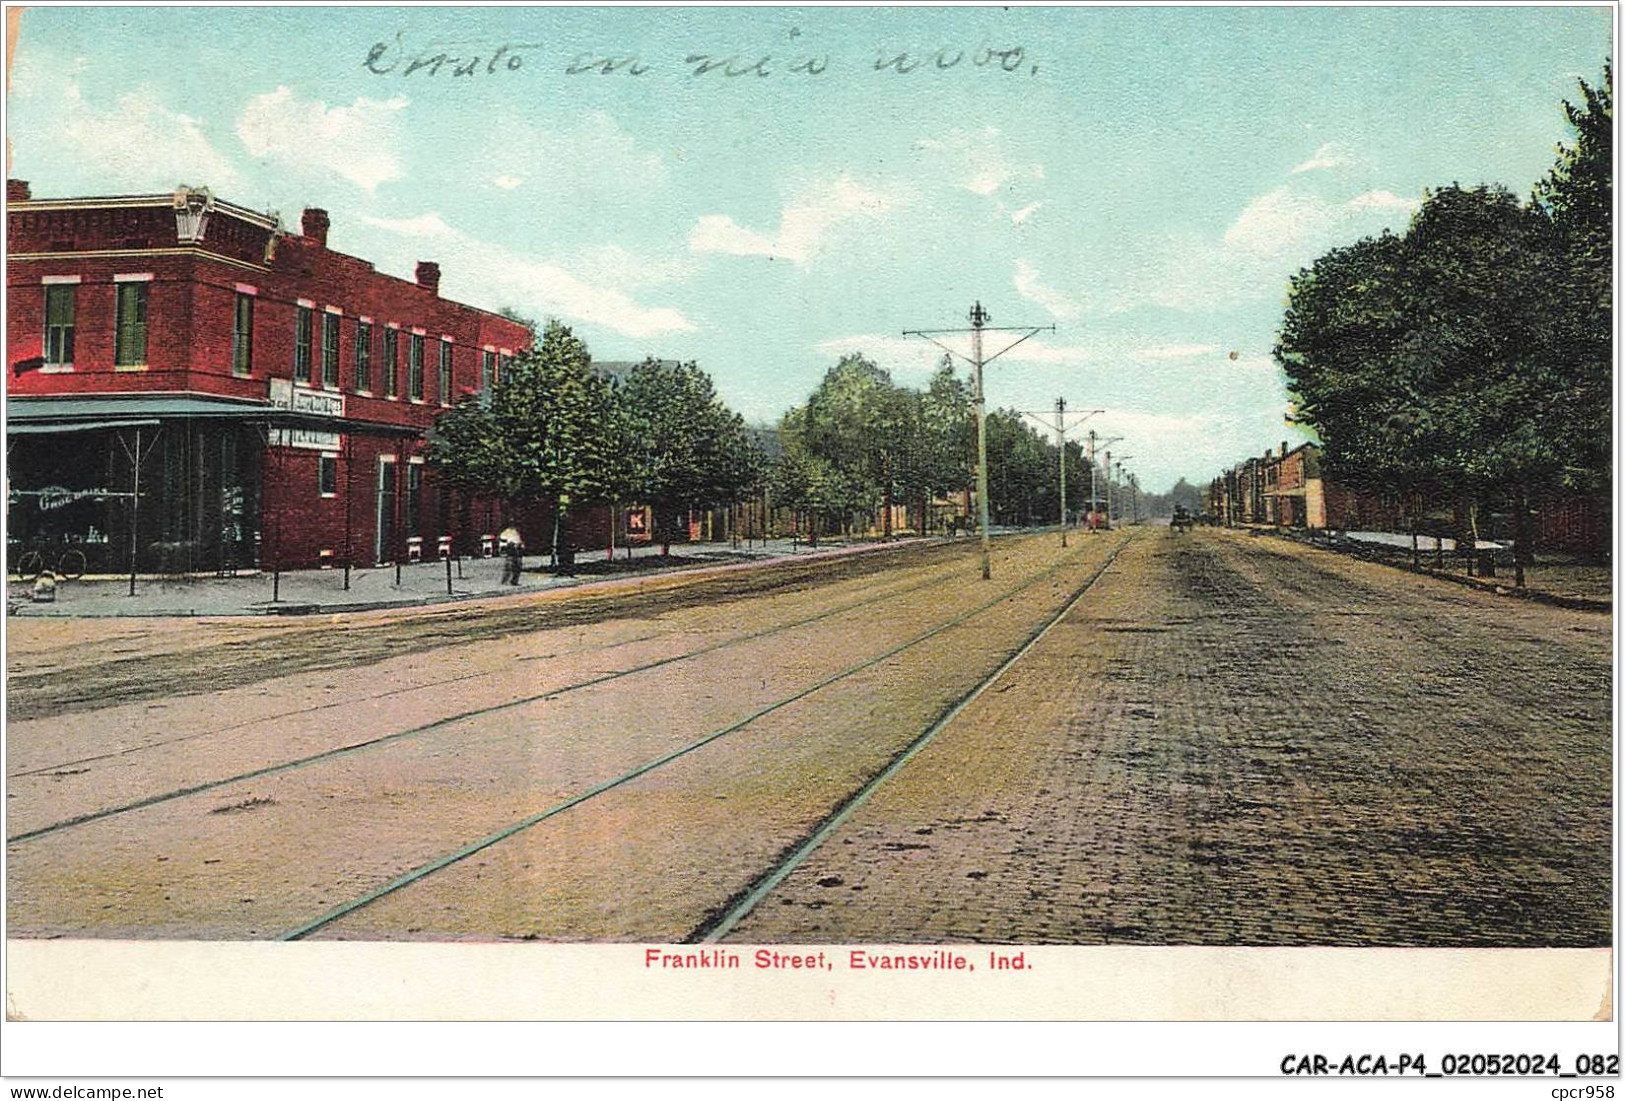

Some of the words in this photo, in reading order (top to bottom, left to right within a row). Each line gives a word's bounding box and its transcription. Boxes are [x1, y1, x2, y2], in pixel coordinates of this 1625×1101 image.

[645, 949, 740, 969] Franklin
[754, 949, 834, 972] Street,
[849, 950, 976, 972] Evansville,
[989, 951, 1033, 970] Ind.
